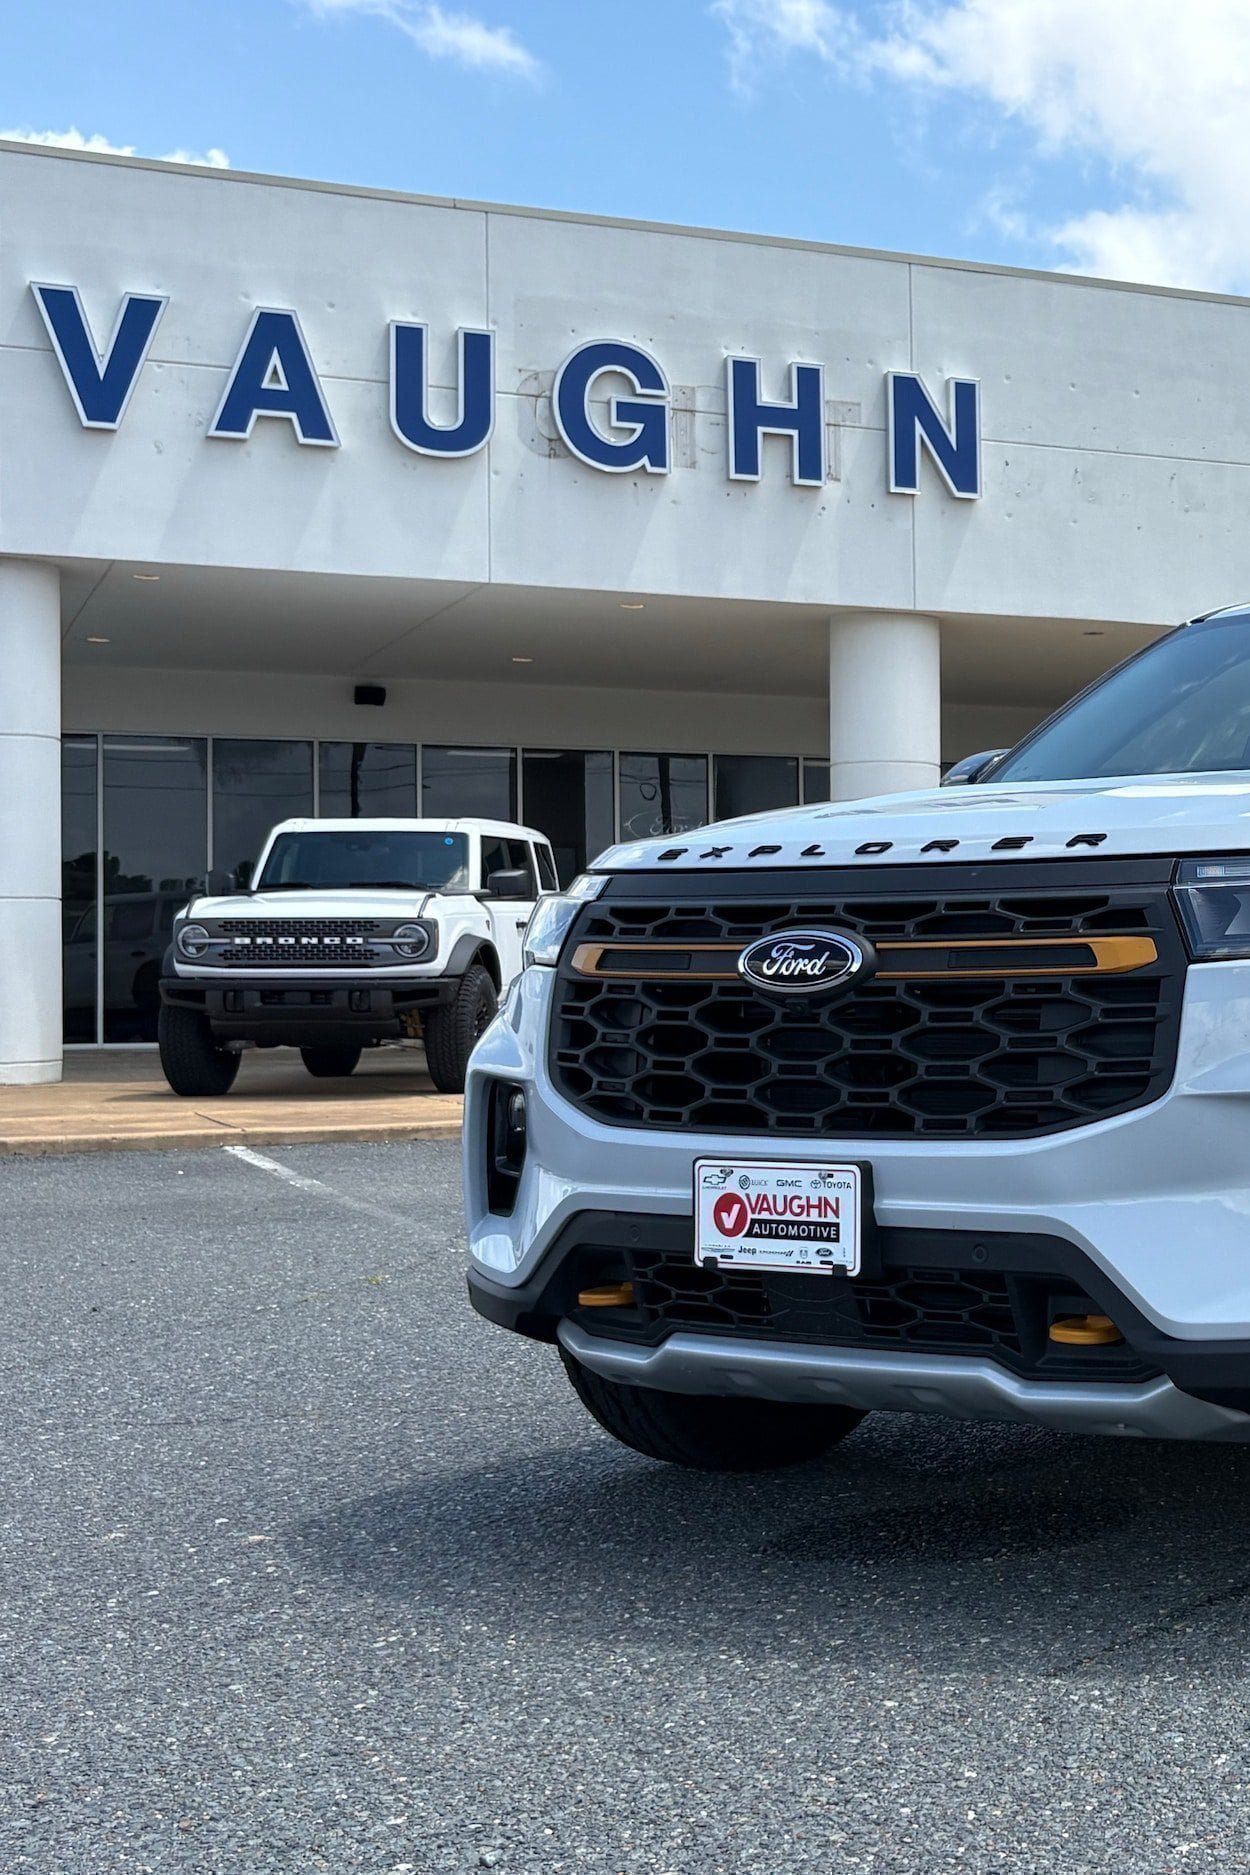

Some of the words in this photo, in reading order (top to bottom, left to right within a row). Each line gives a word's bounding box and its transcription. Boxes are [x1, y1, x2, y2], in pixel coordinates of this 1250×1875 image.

[29, 280, 982, 501] VAUGHN
[656, 832, 1108, 861] EXPLORER
[234, 936, 364, 945] BRONCO
[762, 942, 831, 976] Ford
[776, 1179, 803, 1188] GMC
[822, 1180, 852, 1190] TOYOTA
[745, 1192, 840, 1219] VAUGHN
[752, 1222, 838, 1239] AUTOMOTIVE
[738, 1245, 757, 1256] Jeep
